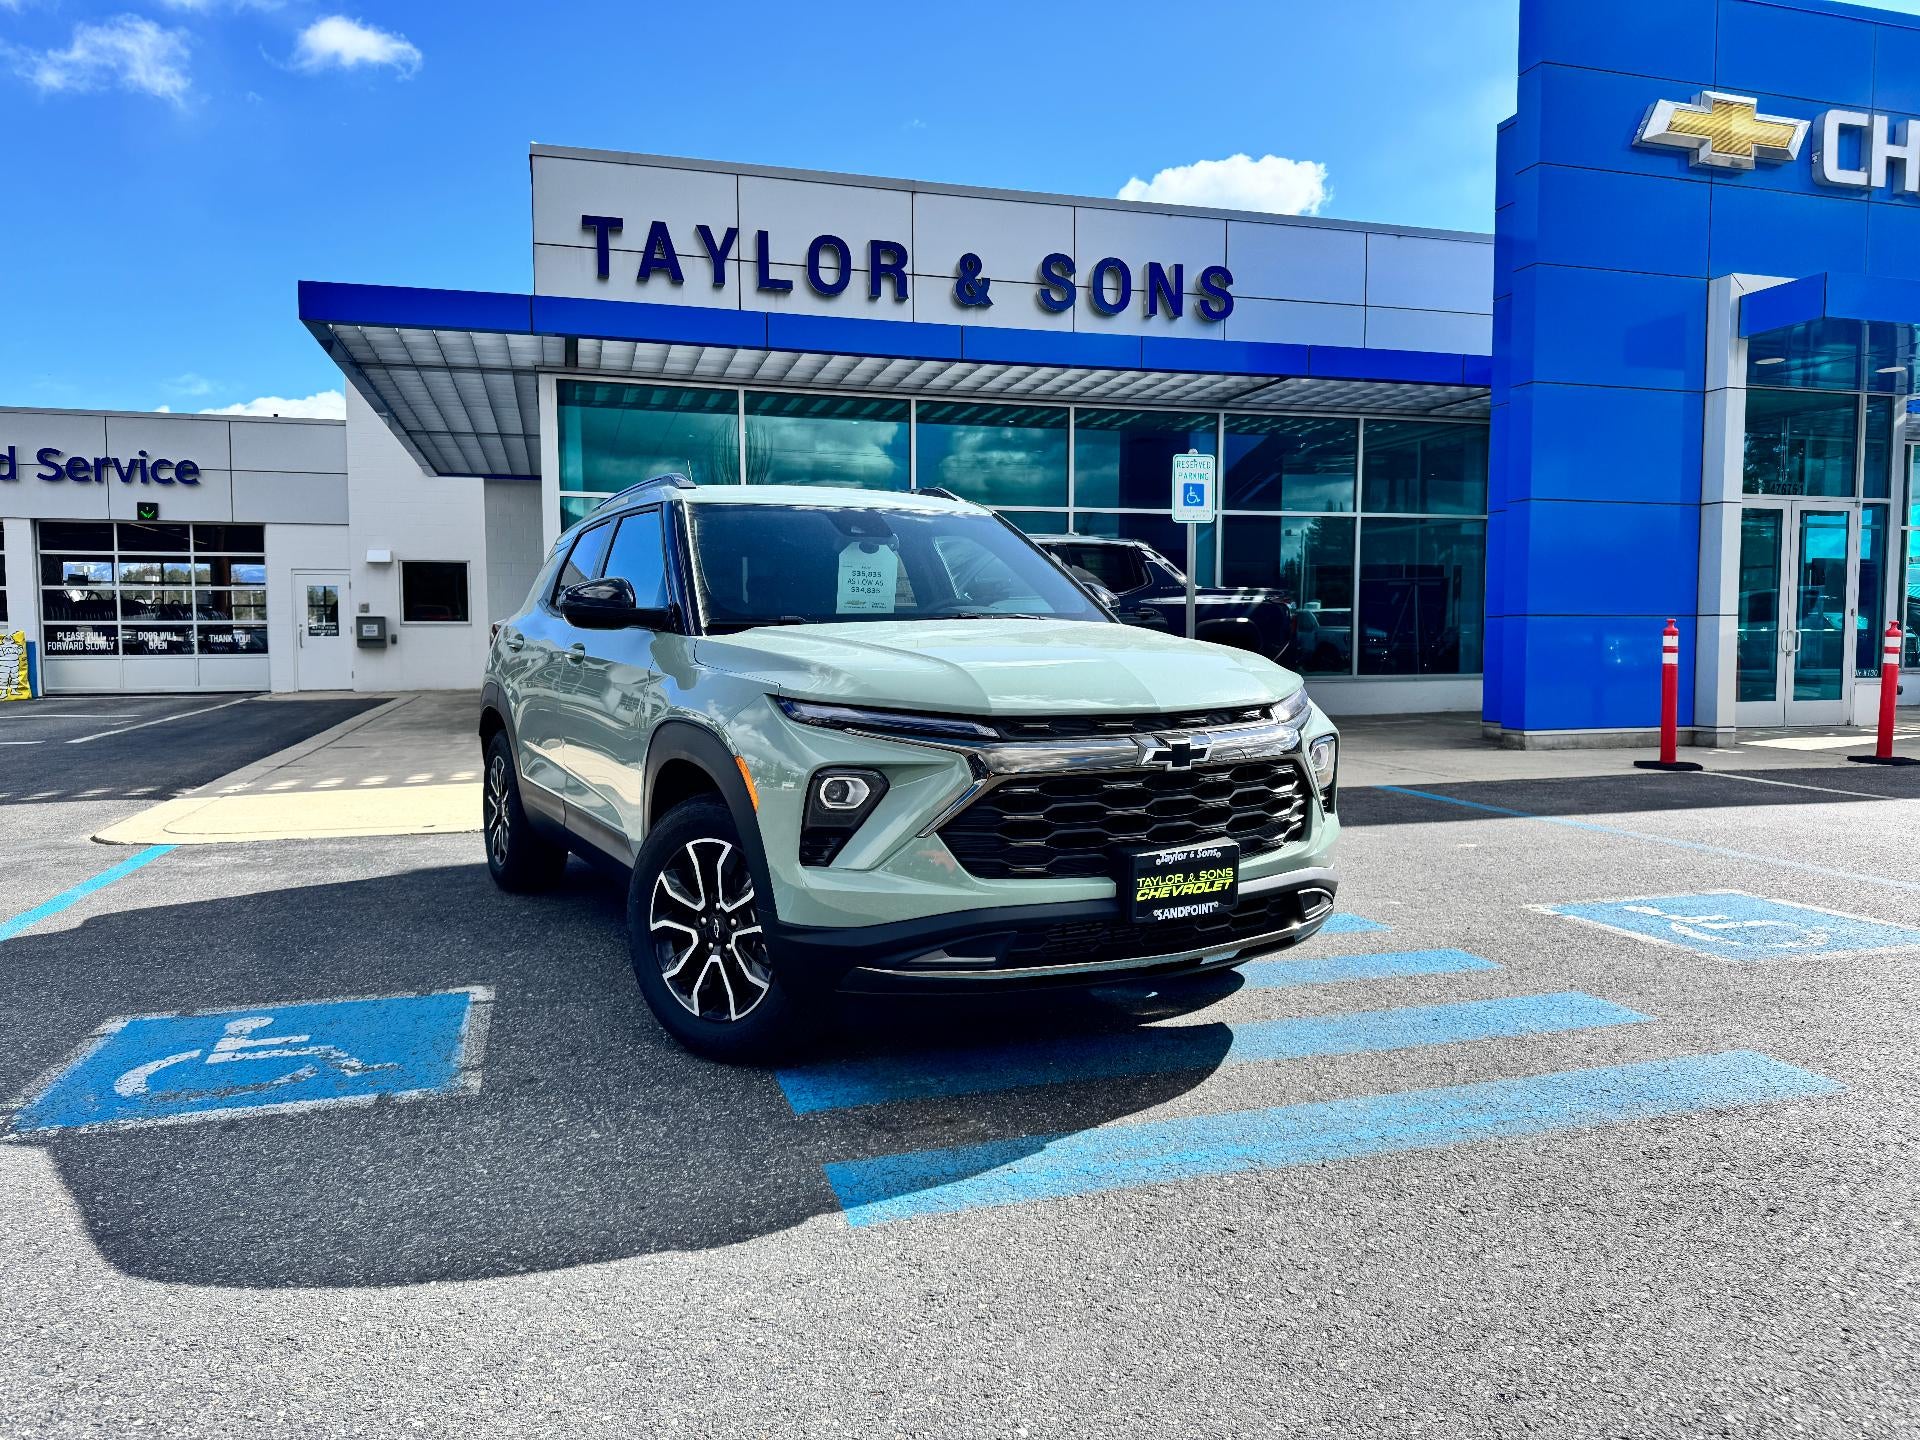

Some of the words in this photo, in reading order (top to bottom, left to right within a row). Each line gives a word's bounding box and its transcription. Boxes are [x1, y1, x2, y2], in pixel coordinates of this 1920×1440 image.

[1812, 109, 1920, 192] CH
[581, 214, 909, 300] TAYLOR
[952, 252, 993, 307] &
[1036, 252, 1235, 322] SONS
[36, 447, 200, 486] Service
[1176, 460, 1211, 469] RESERVED
[1178, 472, 1209, 480] PARKING
[57, 632, 84, 640] PLEASE
[86, 631, 104, 640] PULL
[138, 632, 158, 640] DOOR
[160, 632, 177, 641] WILL
[209, 634, 233, 643] THANK
[47, 641, 84, 650] FORWARD
[86, 641, 114, 650] SLOWLY
[149, 641, 168, 649] OPEN
[1160, 852, 1187, 865] Taylor
[1197, 848, 1217, 859] Sons
[1137, 873, 1184, 888] TAYLOR
[1187, 872, 1195, 883] &
[1199, 867, 1233, 880] SONS
[1136, 879, 1234, 901] CHEVROLET
[1157, 902, 1215, 920] SANDPOINT
